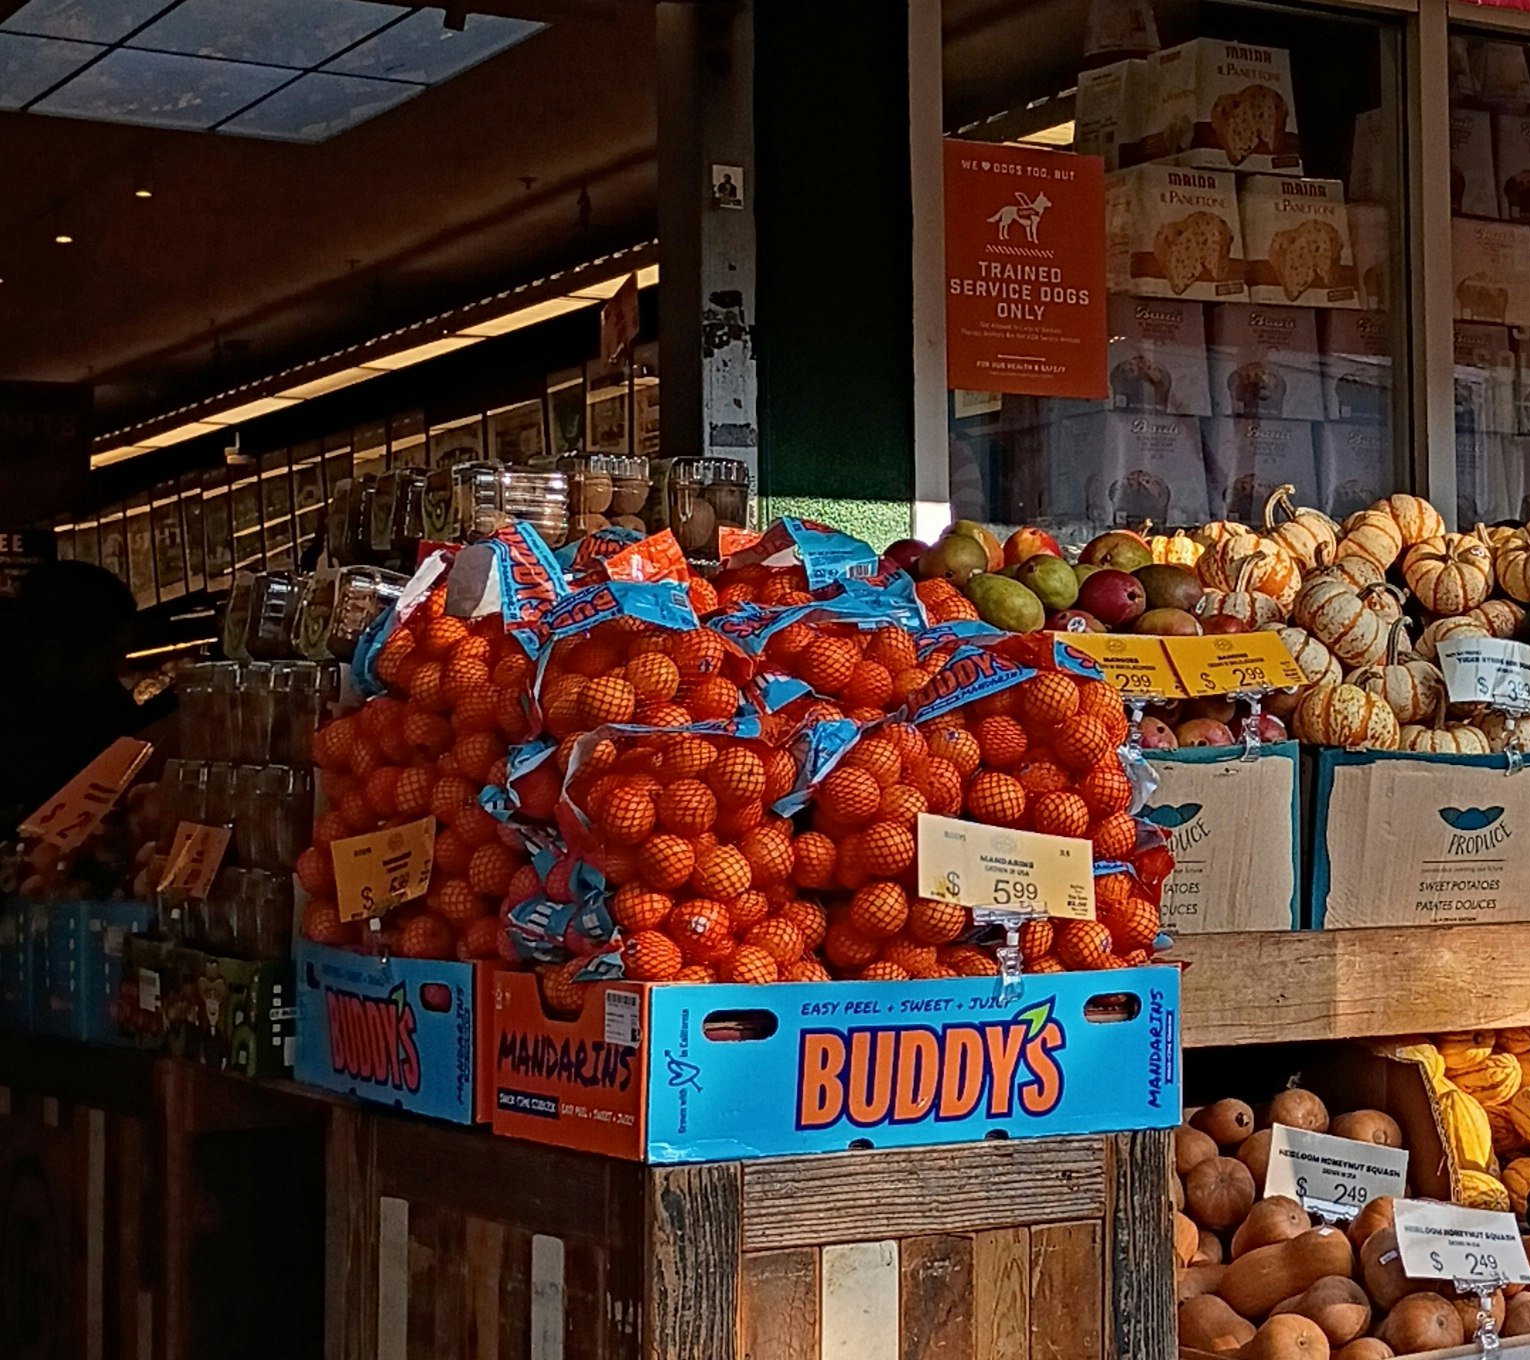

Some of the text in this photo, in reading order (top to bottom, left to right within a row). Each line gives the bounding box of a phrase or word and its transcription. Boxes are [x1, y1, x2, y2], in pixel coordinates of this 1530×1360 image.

[961, 160, 978, 170] WE
[993, 163, 1022, 175] DOGS
[1055, 170, 1075, 180] BUT
[979, 261, 1061, 282] TRAINED
[951, 279, 1089, 305] SERVICE DOGS
[997, 303, 1045, 320] ONLY
[1201, 672, 1216, 690] $
[1476, 676, 1489, 696] $
[1448, 820, 1512, 855] PRODUCE
[980, 855, 1034, 869] MANDARINS
[946, 871, 960, 897] $
[1419, 880, 1500, 891] SWEET POTATOES
[1415, 899, 1496, 911] PATATES DOUCES
[801, 997, 952, 1016] EASY PEEL SWEET
[1148, 988, 1166, 1109] MANDARINS
[500, 1030, 636, 1091] MANDARINS
[1279, 1149, 1400, 1178] HEIRLOOM HONEYNUT SQUASH
[1296, 1177, 1308, 1197] $
[1485, 1232, 1516, 1241] SQUASH
[1430, 1251, 1444, 1272] $
